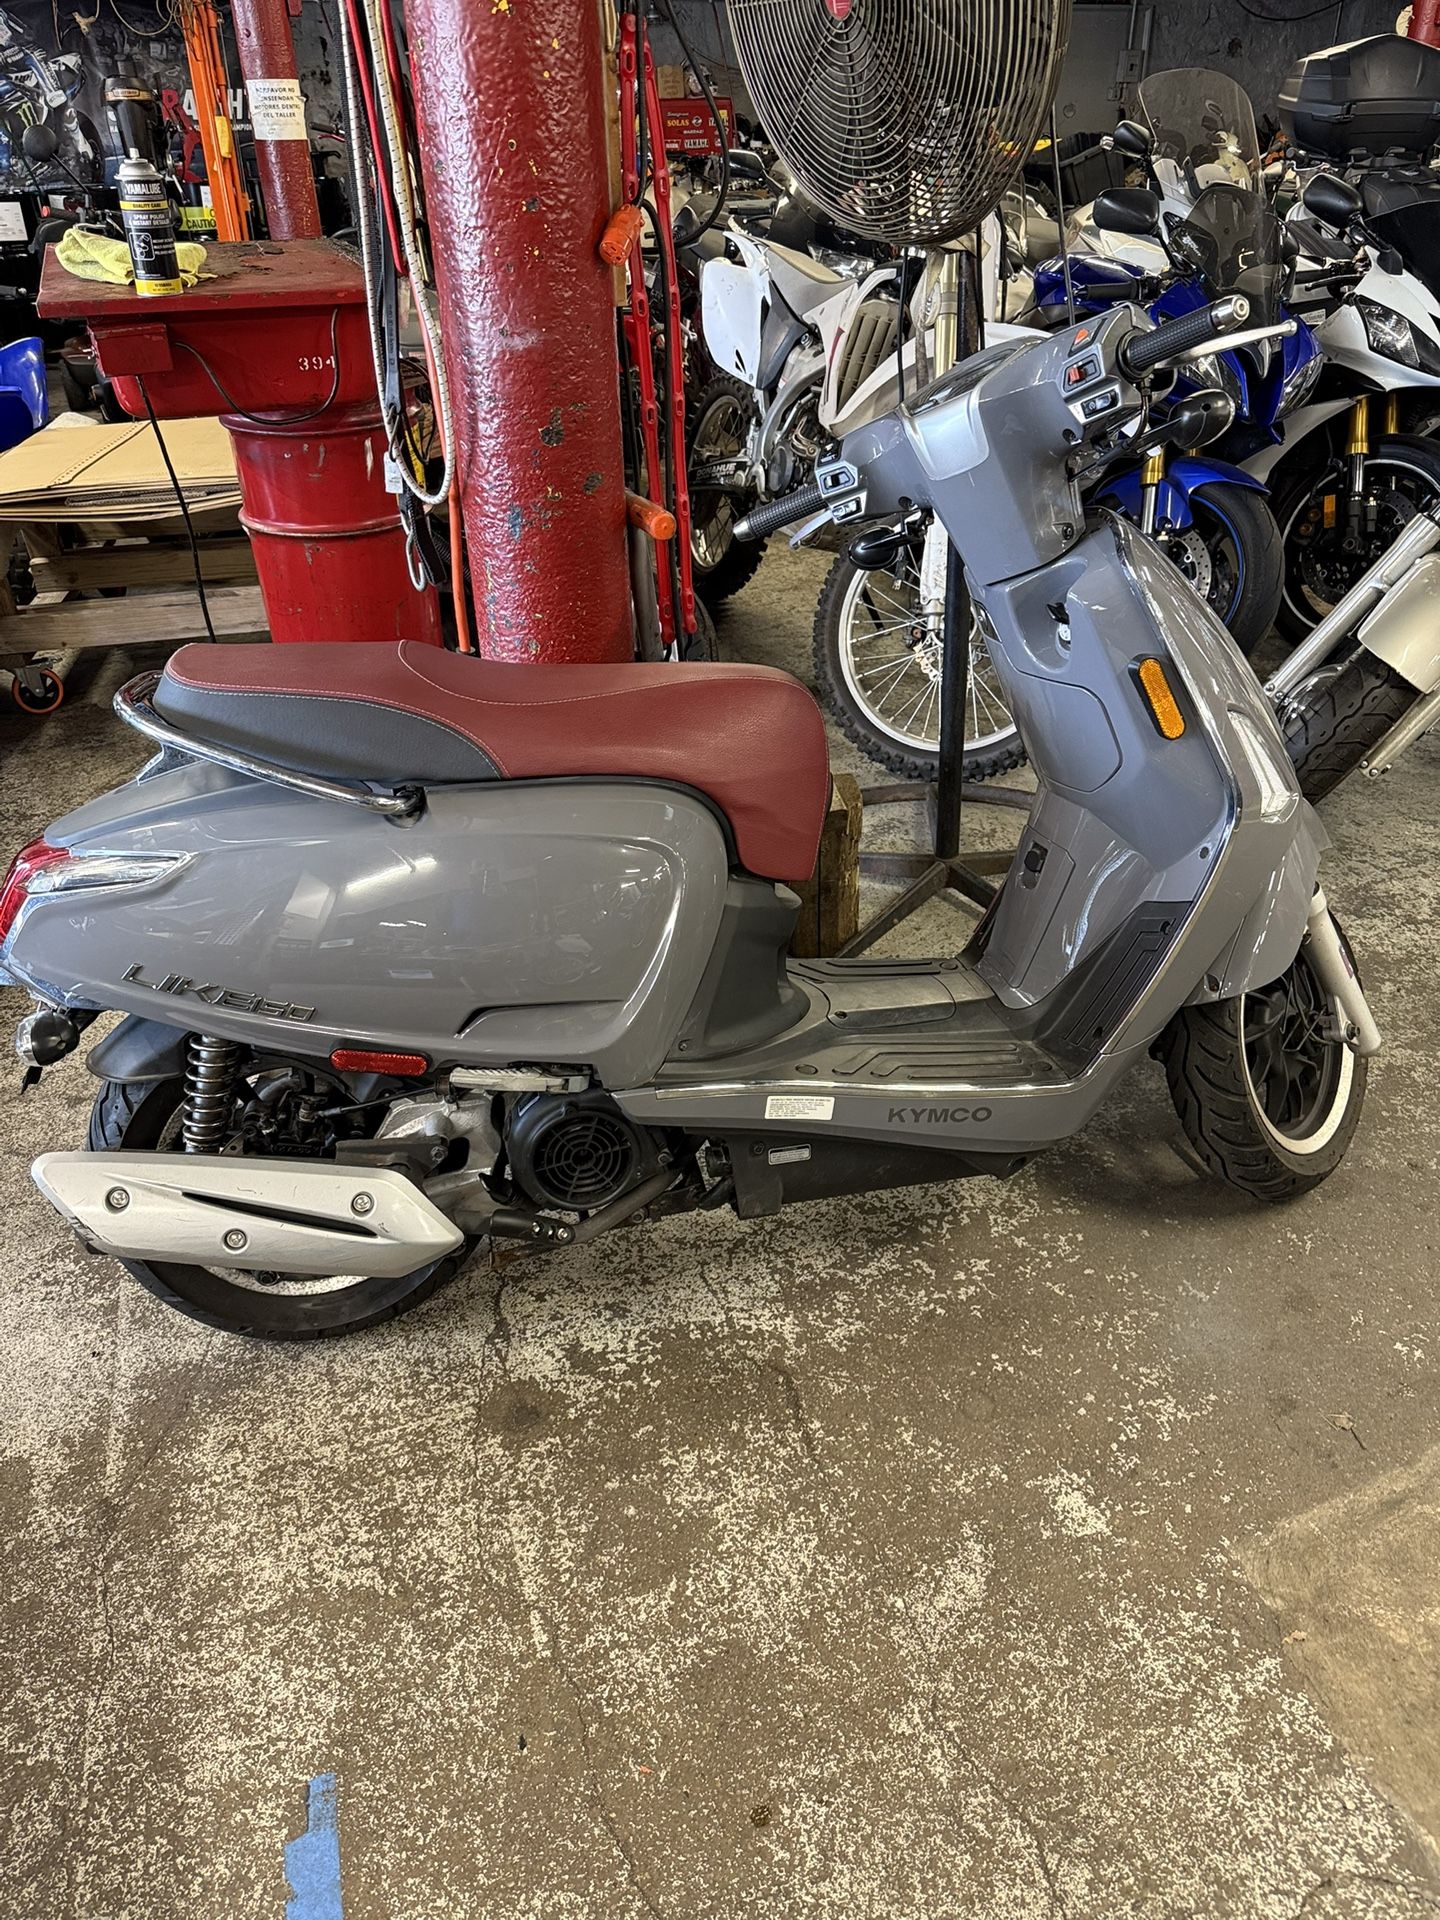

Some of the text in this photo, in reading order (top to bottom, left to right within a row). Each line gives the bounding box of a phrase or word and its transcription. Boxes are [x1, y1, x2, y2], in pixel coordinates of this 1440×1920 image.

[667, 119, 689, 127] SOLAS
[125, 183, 162, 195] YAMALUBE
[186, 218, 217, 230] CAUTIO
[887, 1106, 993, 1123] KYMCO
